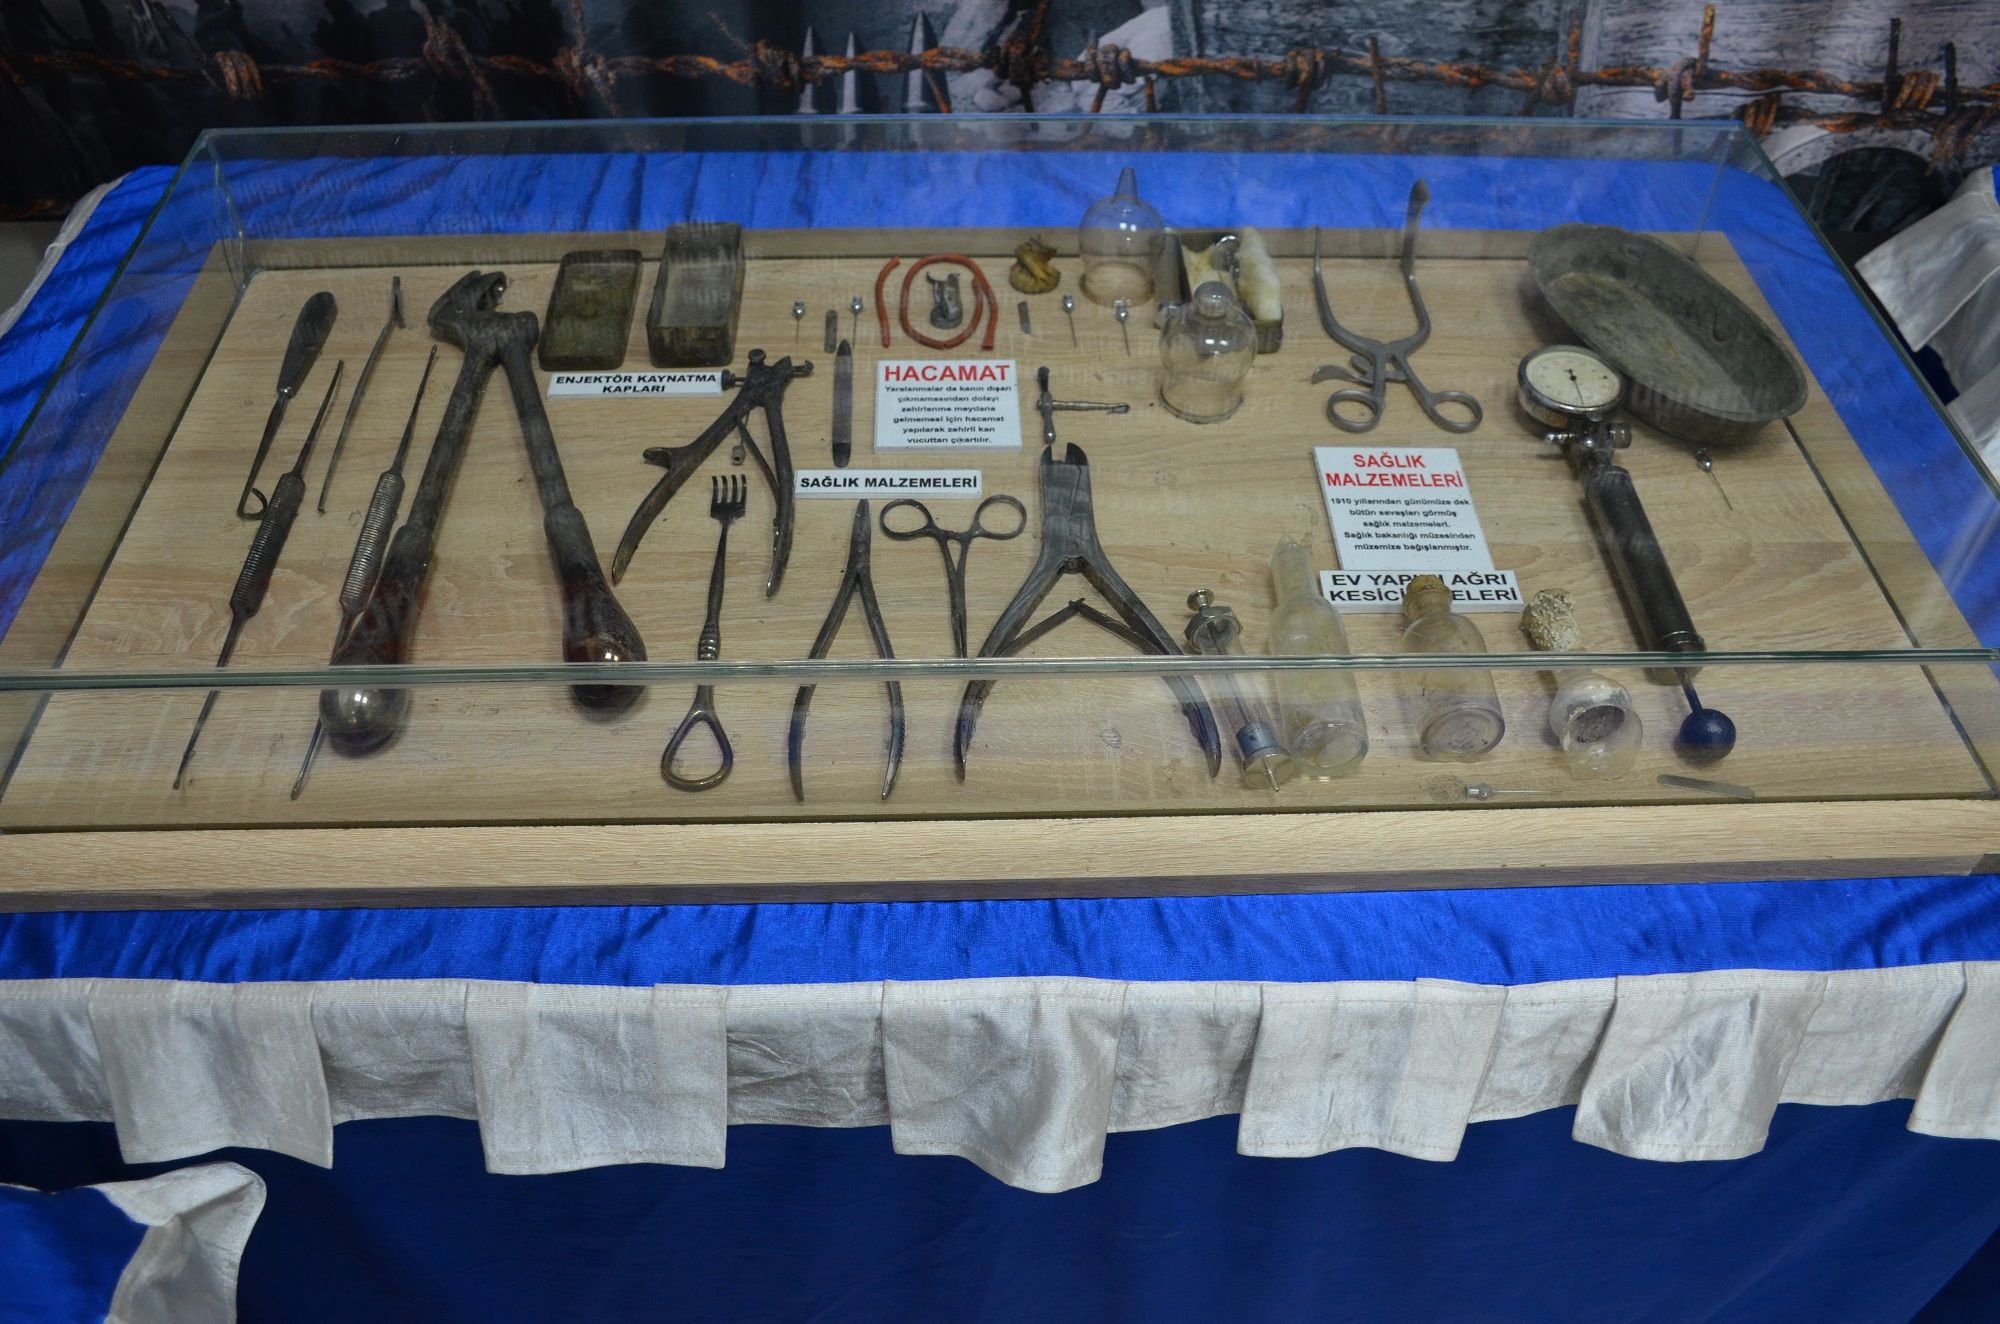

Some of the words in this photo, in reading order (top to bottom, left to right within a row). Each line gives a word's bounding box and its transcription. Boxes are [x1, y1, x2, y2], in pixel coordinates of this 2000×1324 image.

[556, 375, 633, 384] ENJEKTÖR
[637, 375, 716, 383] KAYNATMA
[884, 365, 1010, 381] HACAMAT
[602, 385, 665, 393] KAPLARI
[1353, 452, 1426, 468] SAĞLIK
[800, 476, 859, 488] SAĞLIK
[864, 476, 977, 488] MALZEMELERİ
[1326, 471, 1464, 487] MALZEMELERİ
[1332, 574, 1361, 585] EV
[1451, 571, 1507, 585] AĞRI
